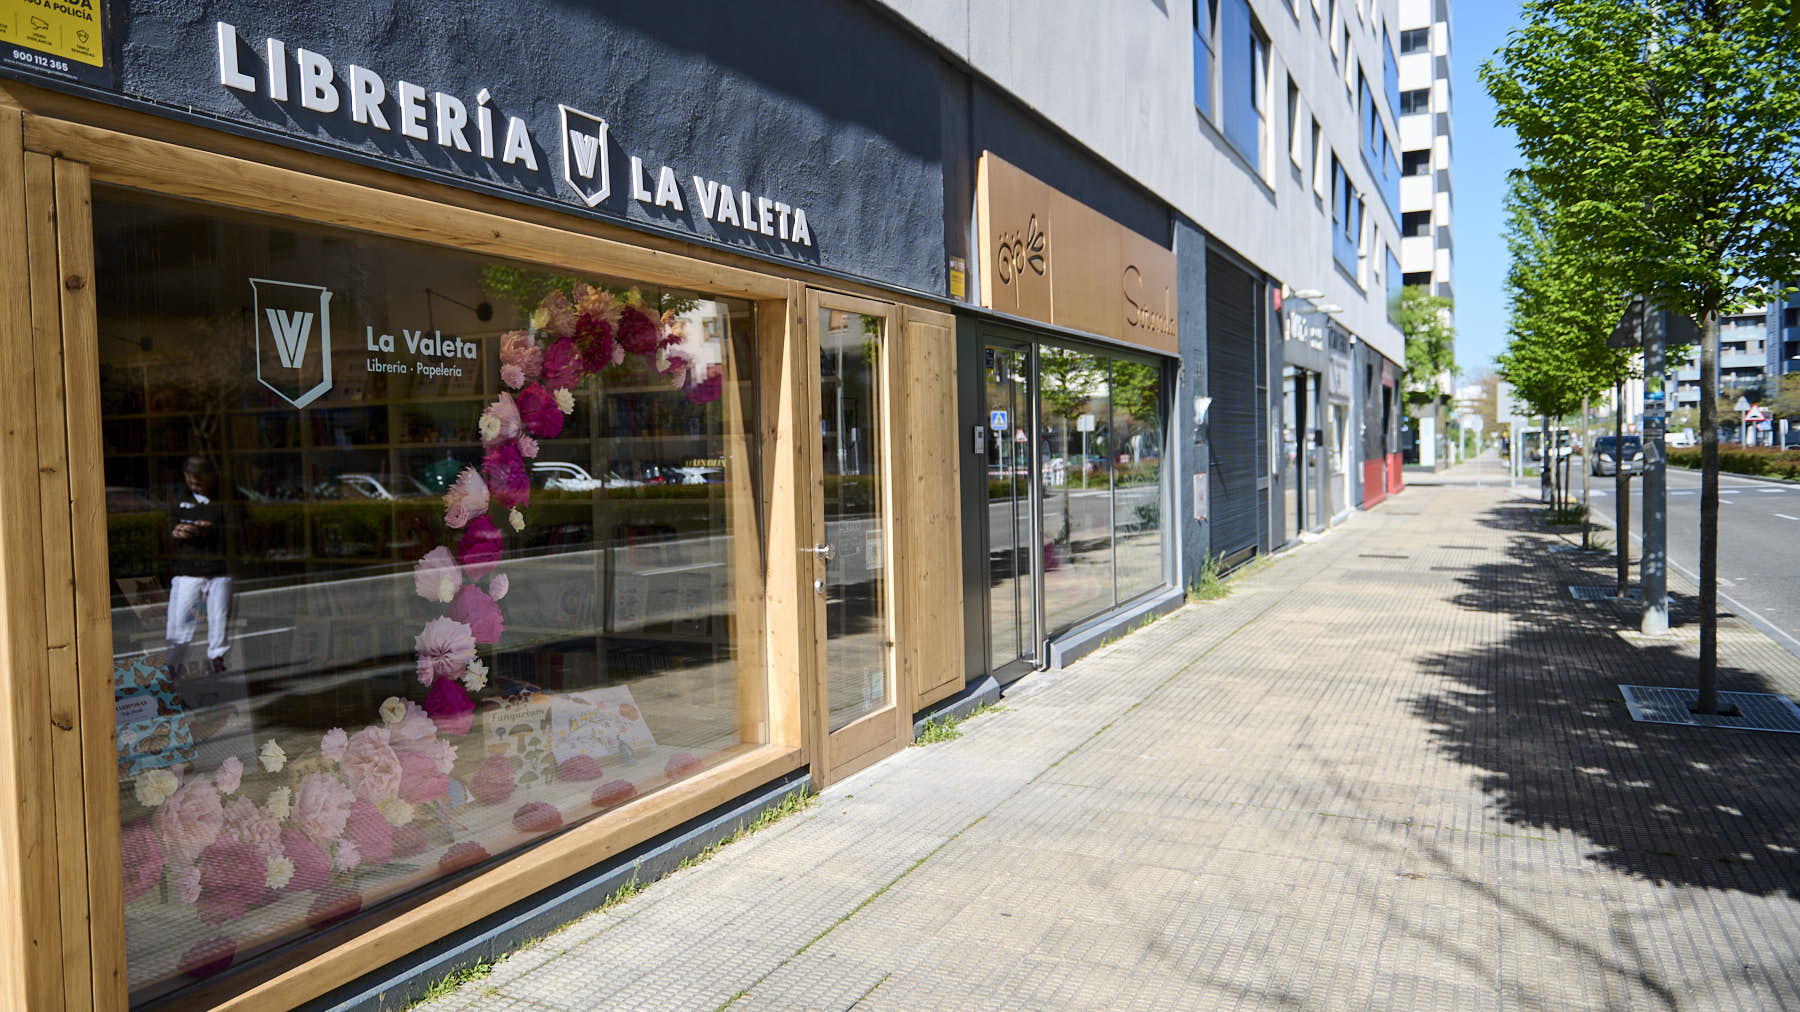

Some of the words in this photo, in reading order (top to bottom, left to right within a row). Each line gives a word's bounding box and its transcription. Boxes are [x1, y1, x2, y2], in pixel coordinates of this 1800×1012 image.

[54, 4, 93, 21] POLICÍA
[13, 50, 32, 62] 900
[34, 56, 48, 66] 112
[50, 60, 68, 72] 365
[217, 21, 539, 171] LIBRERÍA
[631, 155, 684, 212] LA
[693, 175, 812, 247] VALETA
[366, 326, 394, 352] La
[402, 329, 477, 359] Valeta
[416, 361, 462, 379] Papelería
